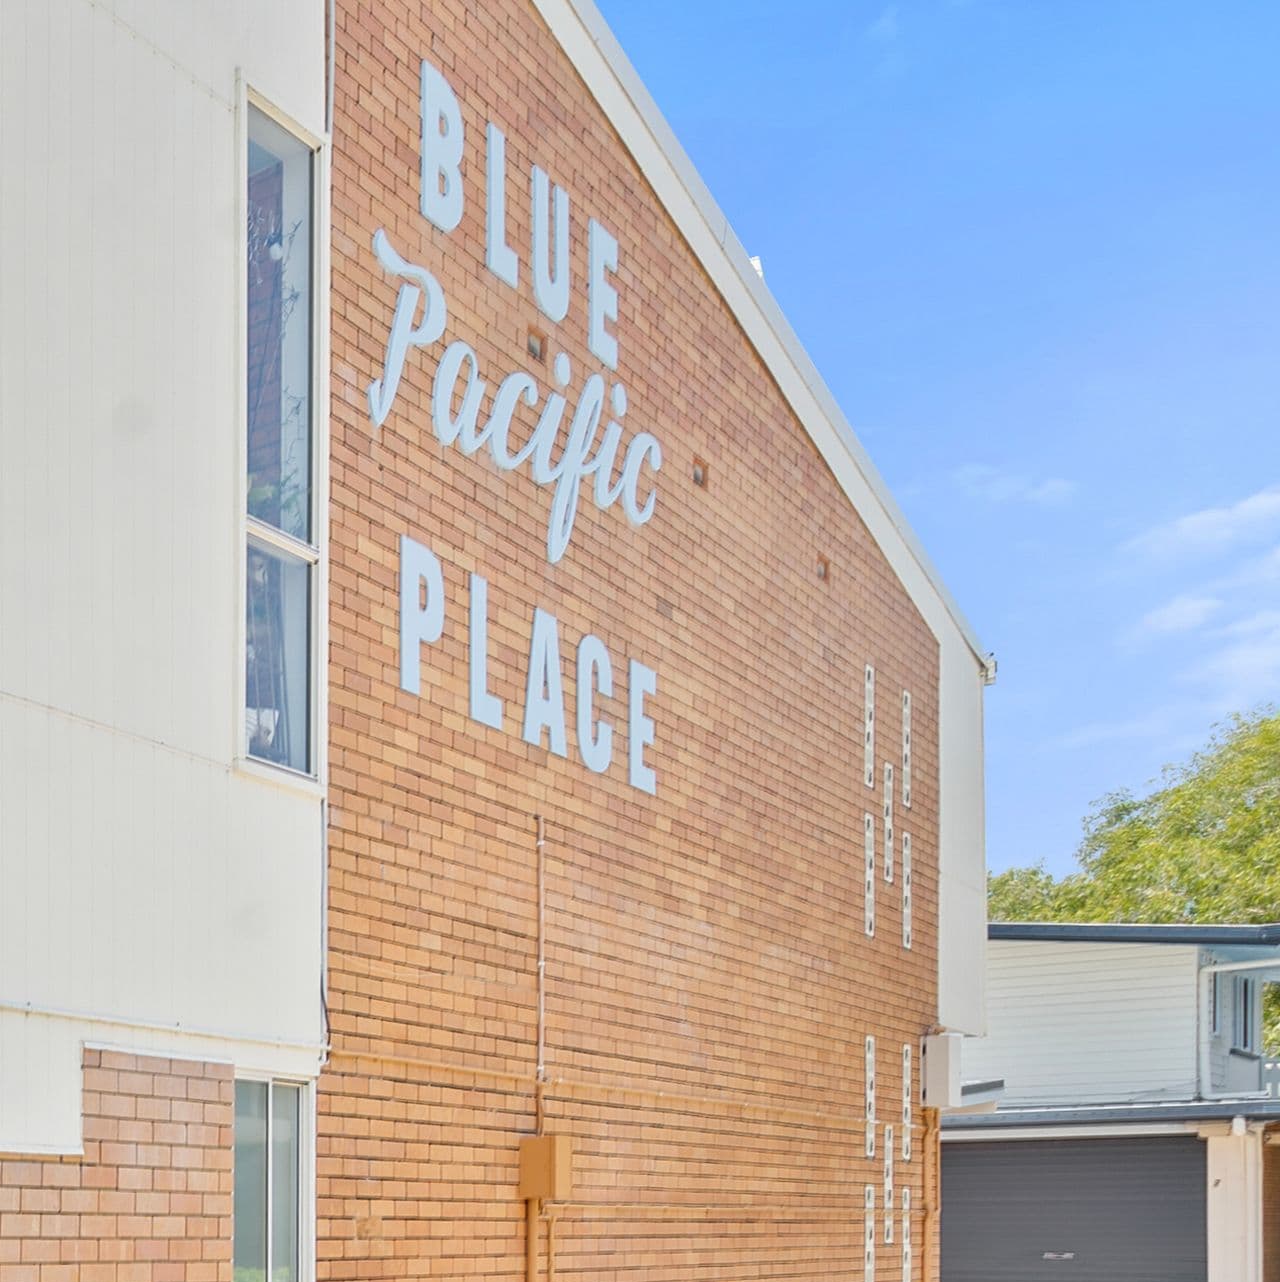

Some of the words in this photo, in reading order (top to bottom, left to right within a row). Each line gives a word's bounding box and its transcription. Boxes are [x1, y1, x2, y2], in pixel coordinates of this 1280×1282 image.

[420, 59, 620, 371] BLUE
[368, 227, 664, 565] Pacific
[399, 534, 658, 796] PLACE
